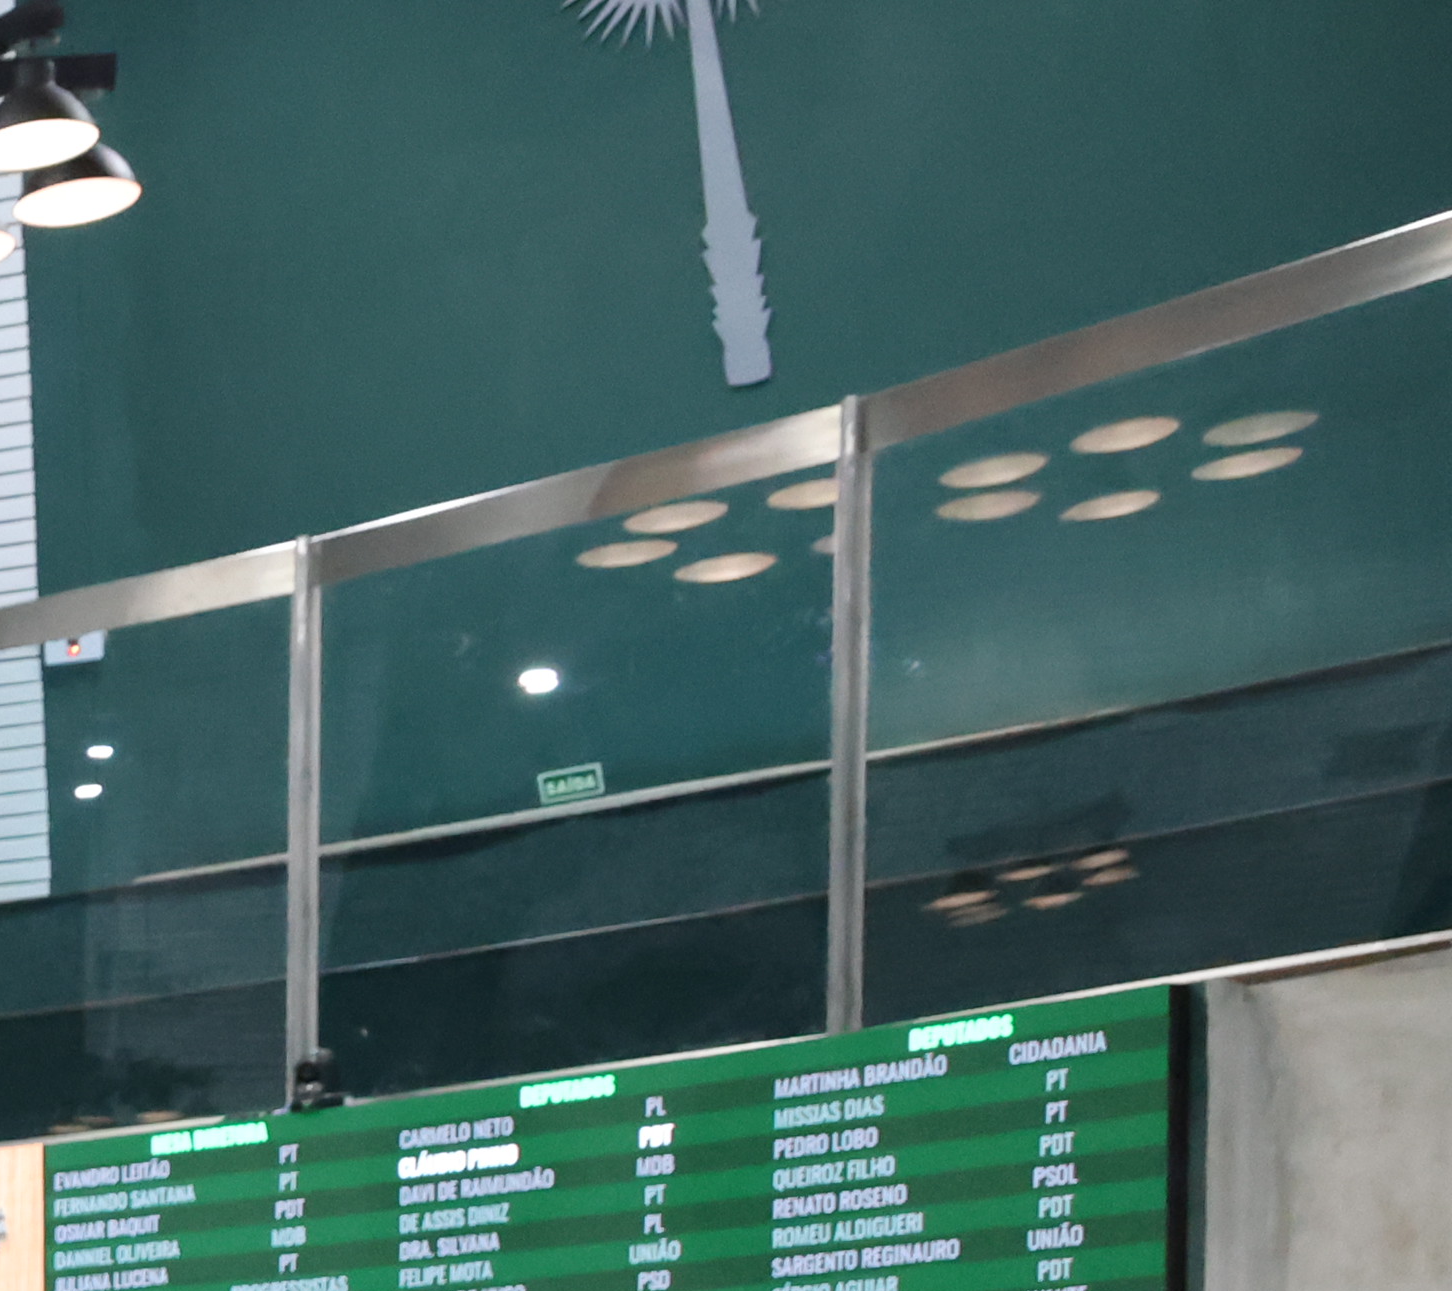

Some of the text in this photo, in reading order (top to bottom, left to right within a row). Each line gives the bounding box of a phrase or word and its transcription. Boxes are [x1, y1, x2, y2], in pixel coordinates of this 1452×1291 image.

[1009, 1030, 1107, 1065] CIDADANIA
[774, 1051, 948, 1098] MARTINHA BRANDÃO
[1046, 1067, 1069, 1091] PT
[645, 1095, 667, 1118] PL
[774, 1094, 885, 1128] MISSIAS DIAS
[1045, 1099, 1069, 1124] PT
[773, 1126, 879, 1159] PEDRO LOBO
[1039, 1131, 1075, 1157] PDT
[773, 1155, 896, 1191] QUEIROZ FILHO
[1032, 1162, 1079, 1189] PSOL
[437, 1179, 459, 1202] DE
[644, 1183, 667, 1206] PT
[772, 1183, 908, 1220] RENATO ROSENO
[1038, 1193, 1075, 1218] PDT
[399, 1212, 420, 1234] DE
[644, 1213, 665, 1234] PL
[772, 1211, 924, 1249] ROMEU ALDIGUERI
[1027, 1221, 1084, 1251] UNIÃO
[771, 1238, 961, 1278] SARGENTO REGINAURO
[1037, 1257, 1074, 1282] PDT
[637, 1269, 671, 1291] PSD
